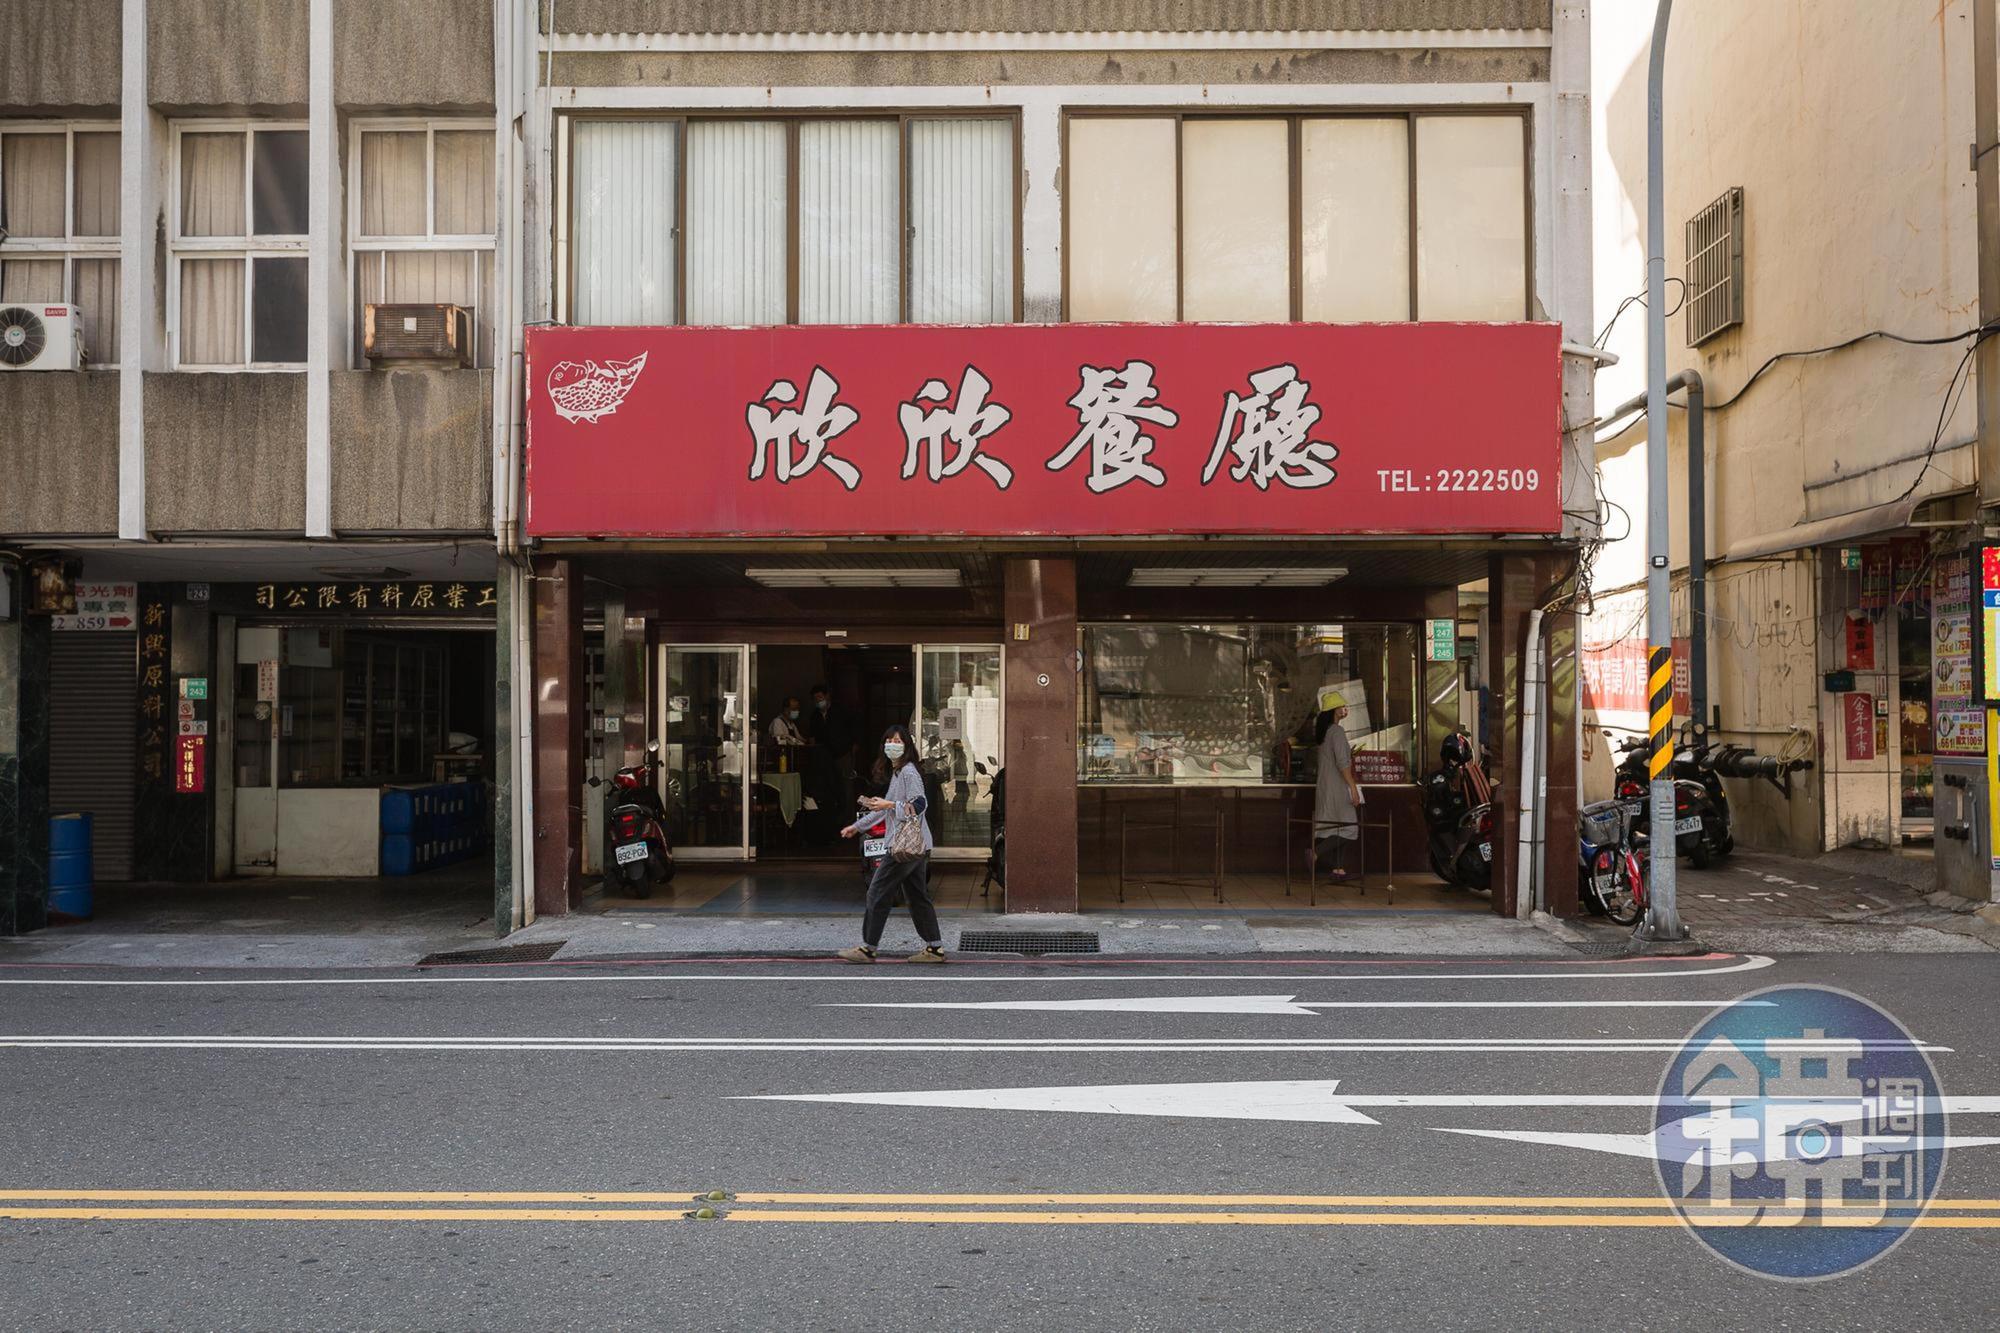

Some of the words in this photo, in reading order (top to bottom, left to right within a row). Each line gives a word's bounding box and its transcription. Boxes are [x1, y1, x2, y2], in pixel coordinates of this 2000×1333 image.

[745, 360, 1340, 493] 欣欣餐廳
[1377, 470, 1539, 492] TEL:2222509
[77, 617, 106, 629] 859
[190, 687, 204, 696] 243
